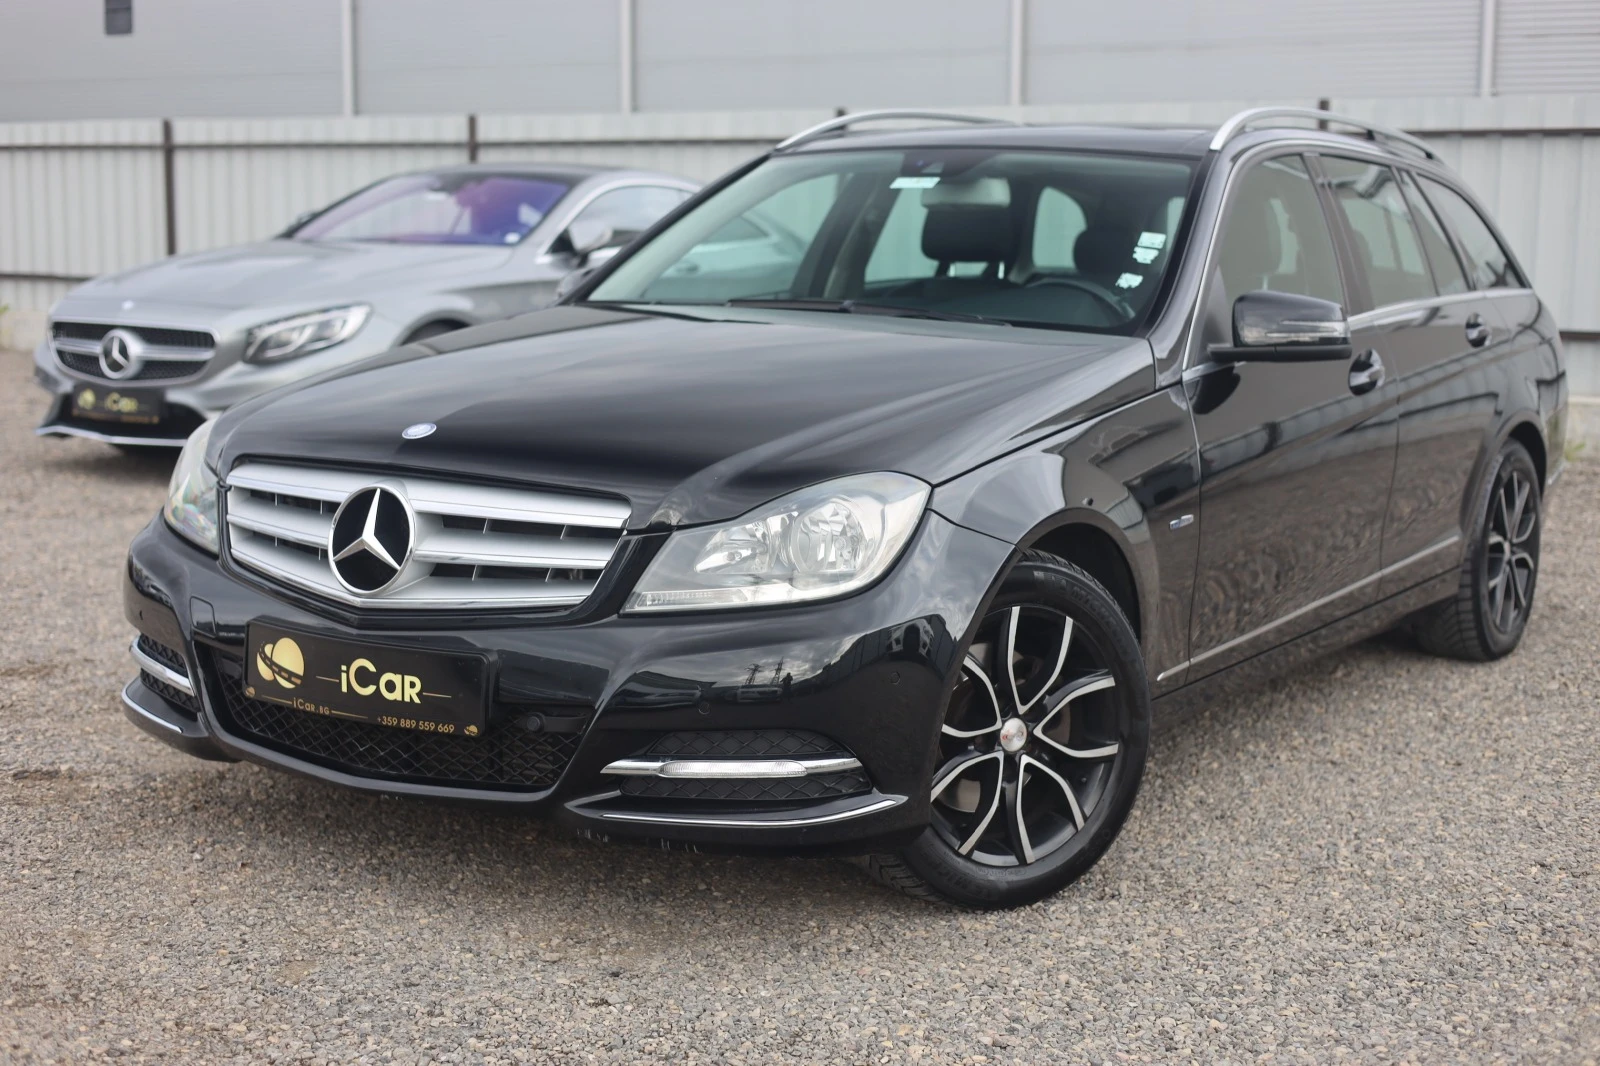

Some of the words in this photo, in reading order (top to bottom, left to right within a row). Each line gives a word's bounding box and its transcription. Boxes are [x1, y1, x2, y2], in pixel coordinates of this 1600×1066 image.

[377, 716, 398, 726] +359
[400, 719, 416, 728] 889
[419, 721, 435, 731] 559
[437, 723, 455, 733] 669
